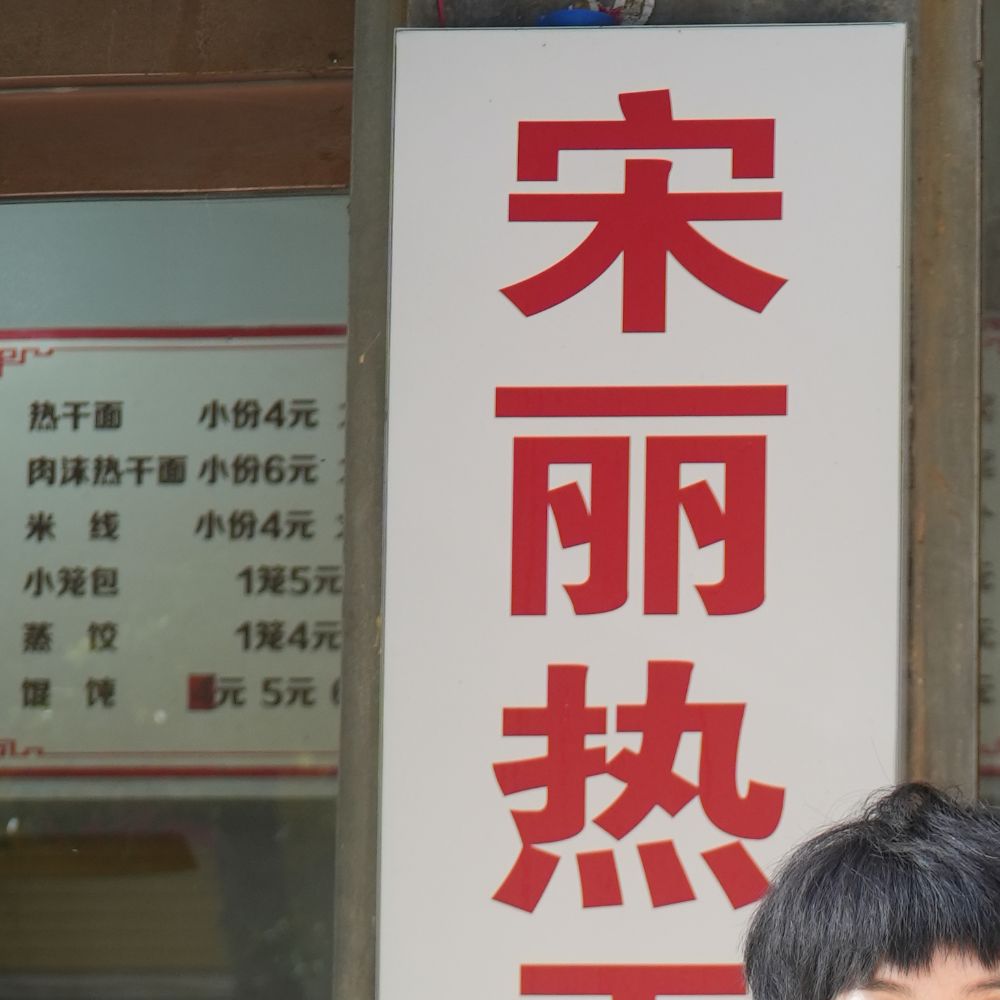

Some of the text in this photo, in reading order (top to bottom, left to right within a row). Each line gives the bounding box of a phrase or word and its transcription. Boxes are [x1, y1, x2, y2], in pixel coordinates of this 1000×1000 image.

[29, 400, 124, 431] 热干面
[198, 399, 319, 430] 小份4元
[28, 455, 188, 486] 肉沫热干面
[198, 454, 318, 485] 小份6元
[194, 509, 316, 541] 小份4元
[23, 564, 342, 598] 小笼包 1笼5元
[234, 619, 341, 652] 1笼4元
[261, 675, 316, 707] 5元
